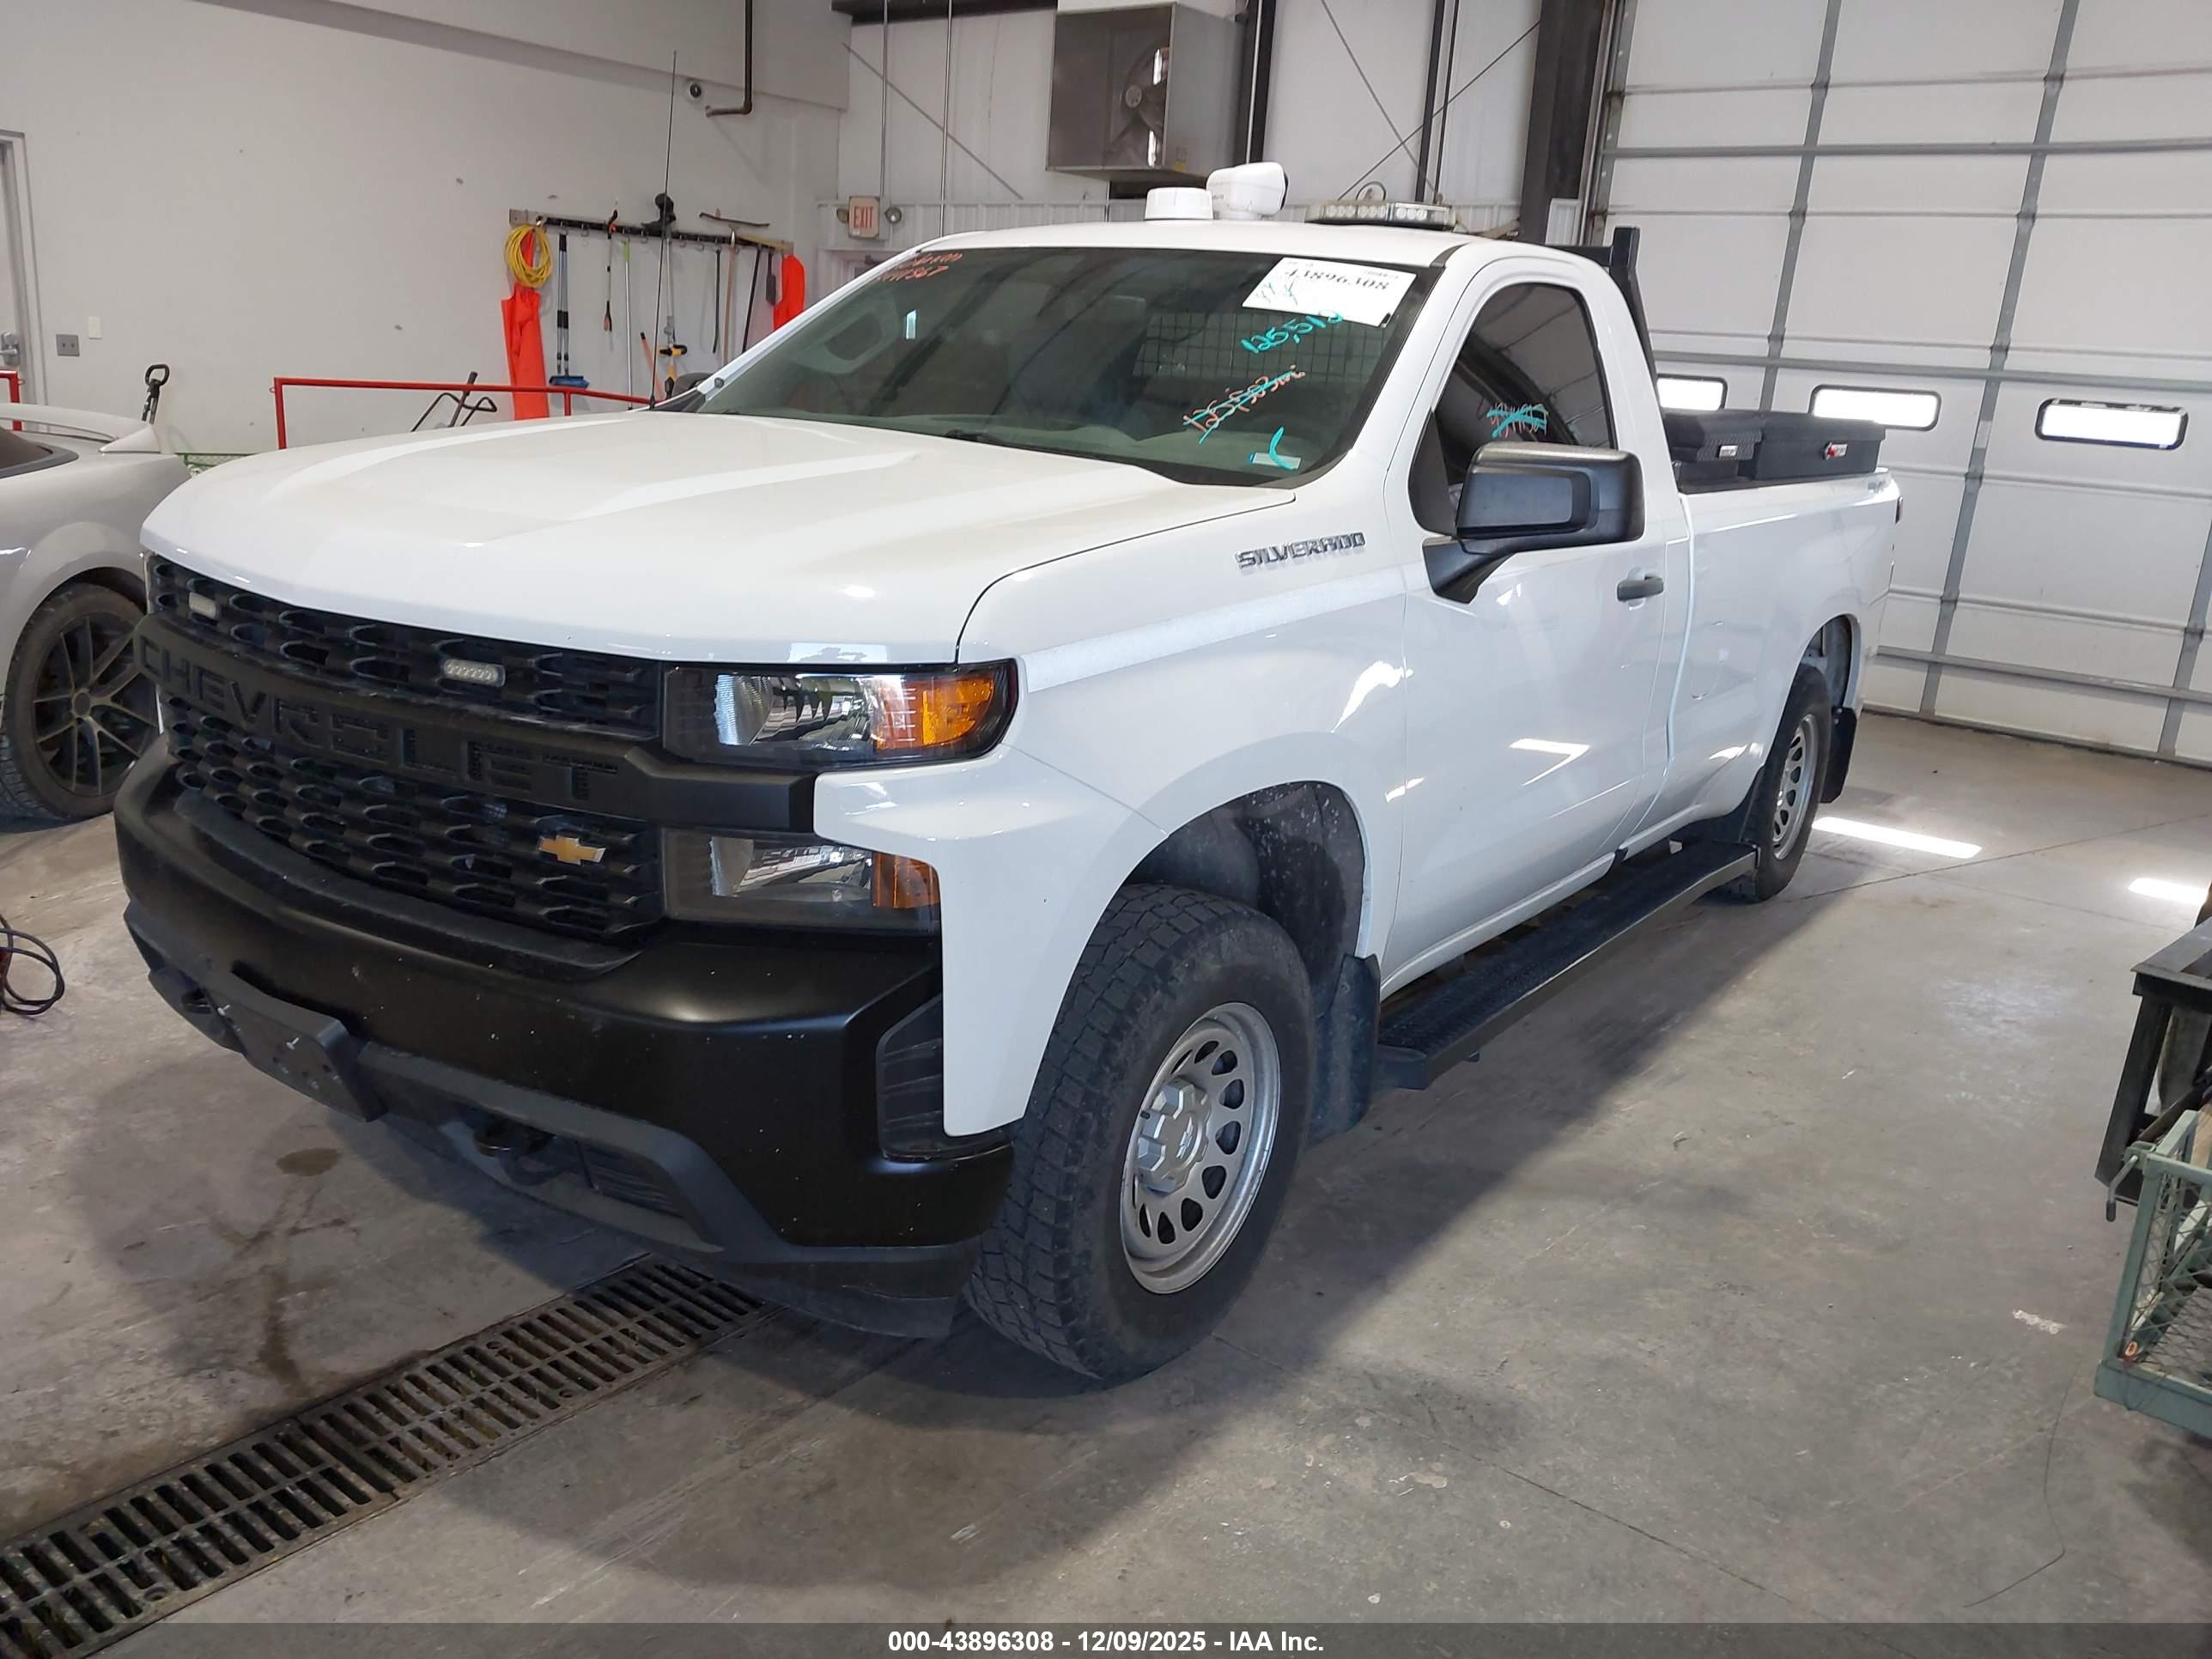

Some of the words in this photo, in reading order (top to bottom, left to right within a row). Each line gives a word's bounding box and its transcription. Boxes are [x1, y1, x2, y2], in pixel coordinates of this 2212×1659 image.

[853, 205, 874, 229] EXIT
[1236, 531, 1366, 569] SILVERADO
[139, 634, 620, 802] CHEVROLET
